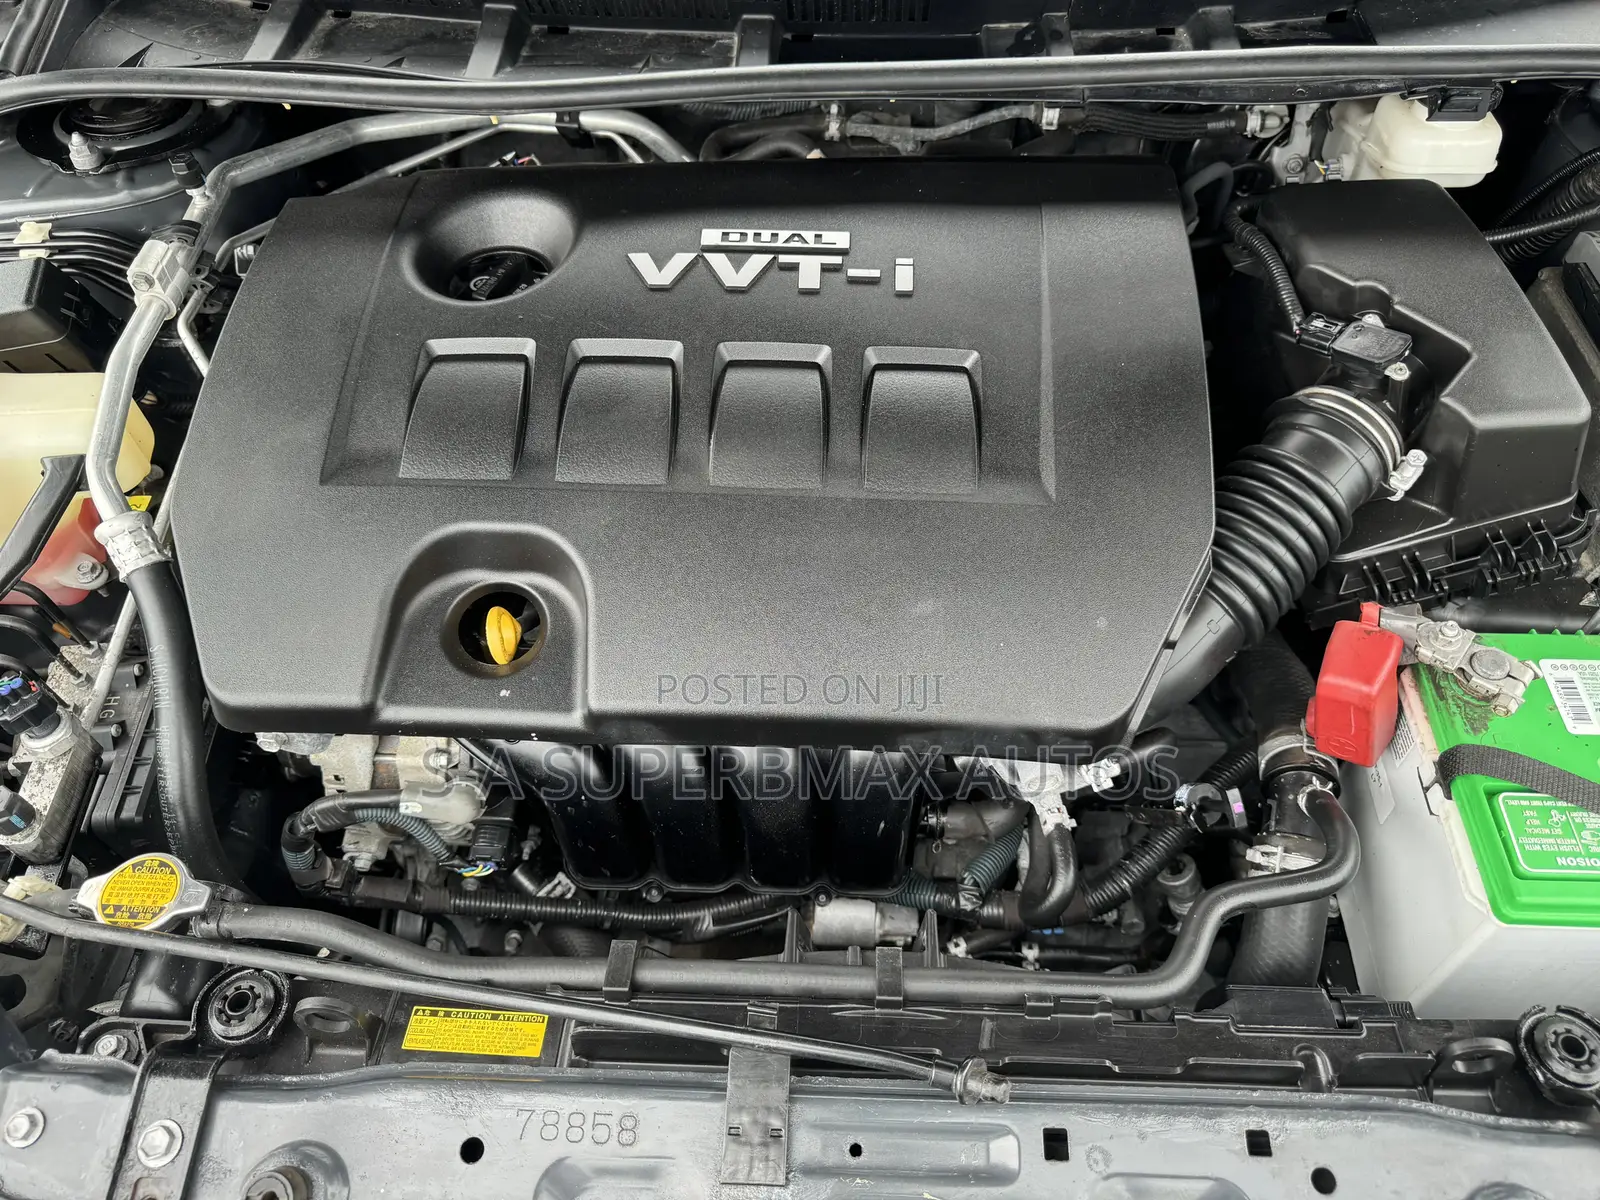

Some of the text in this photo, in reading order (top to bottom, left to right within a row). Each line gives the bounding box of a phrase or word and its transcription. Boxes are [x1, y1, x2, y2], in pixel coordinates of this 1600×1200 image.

[719, 230, 838, 246] DUAL
[627, 252, 915, 296] VVT-i
[1556, 856, 1600, 867] OISON
[134, 866, 172, 875] CAUTION
[120, 905, 161, 913] ATTENTION
[450, 1011, 492, 1020] CAUTION
[498, 1014, 544, 1023] ATTENTION
[516, 1108, 639, 1147] 78858
